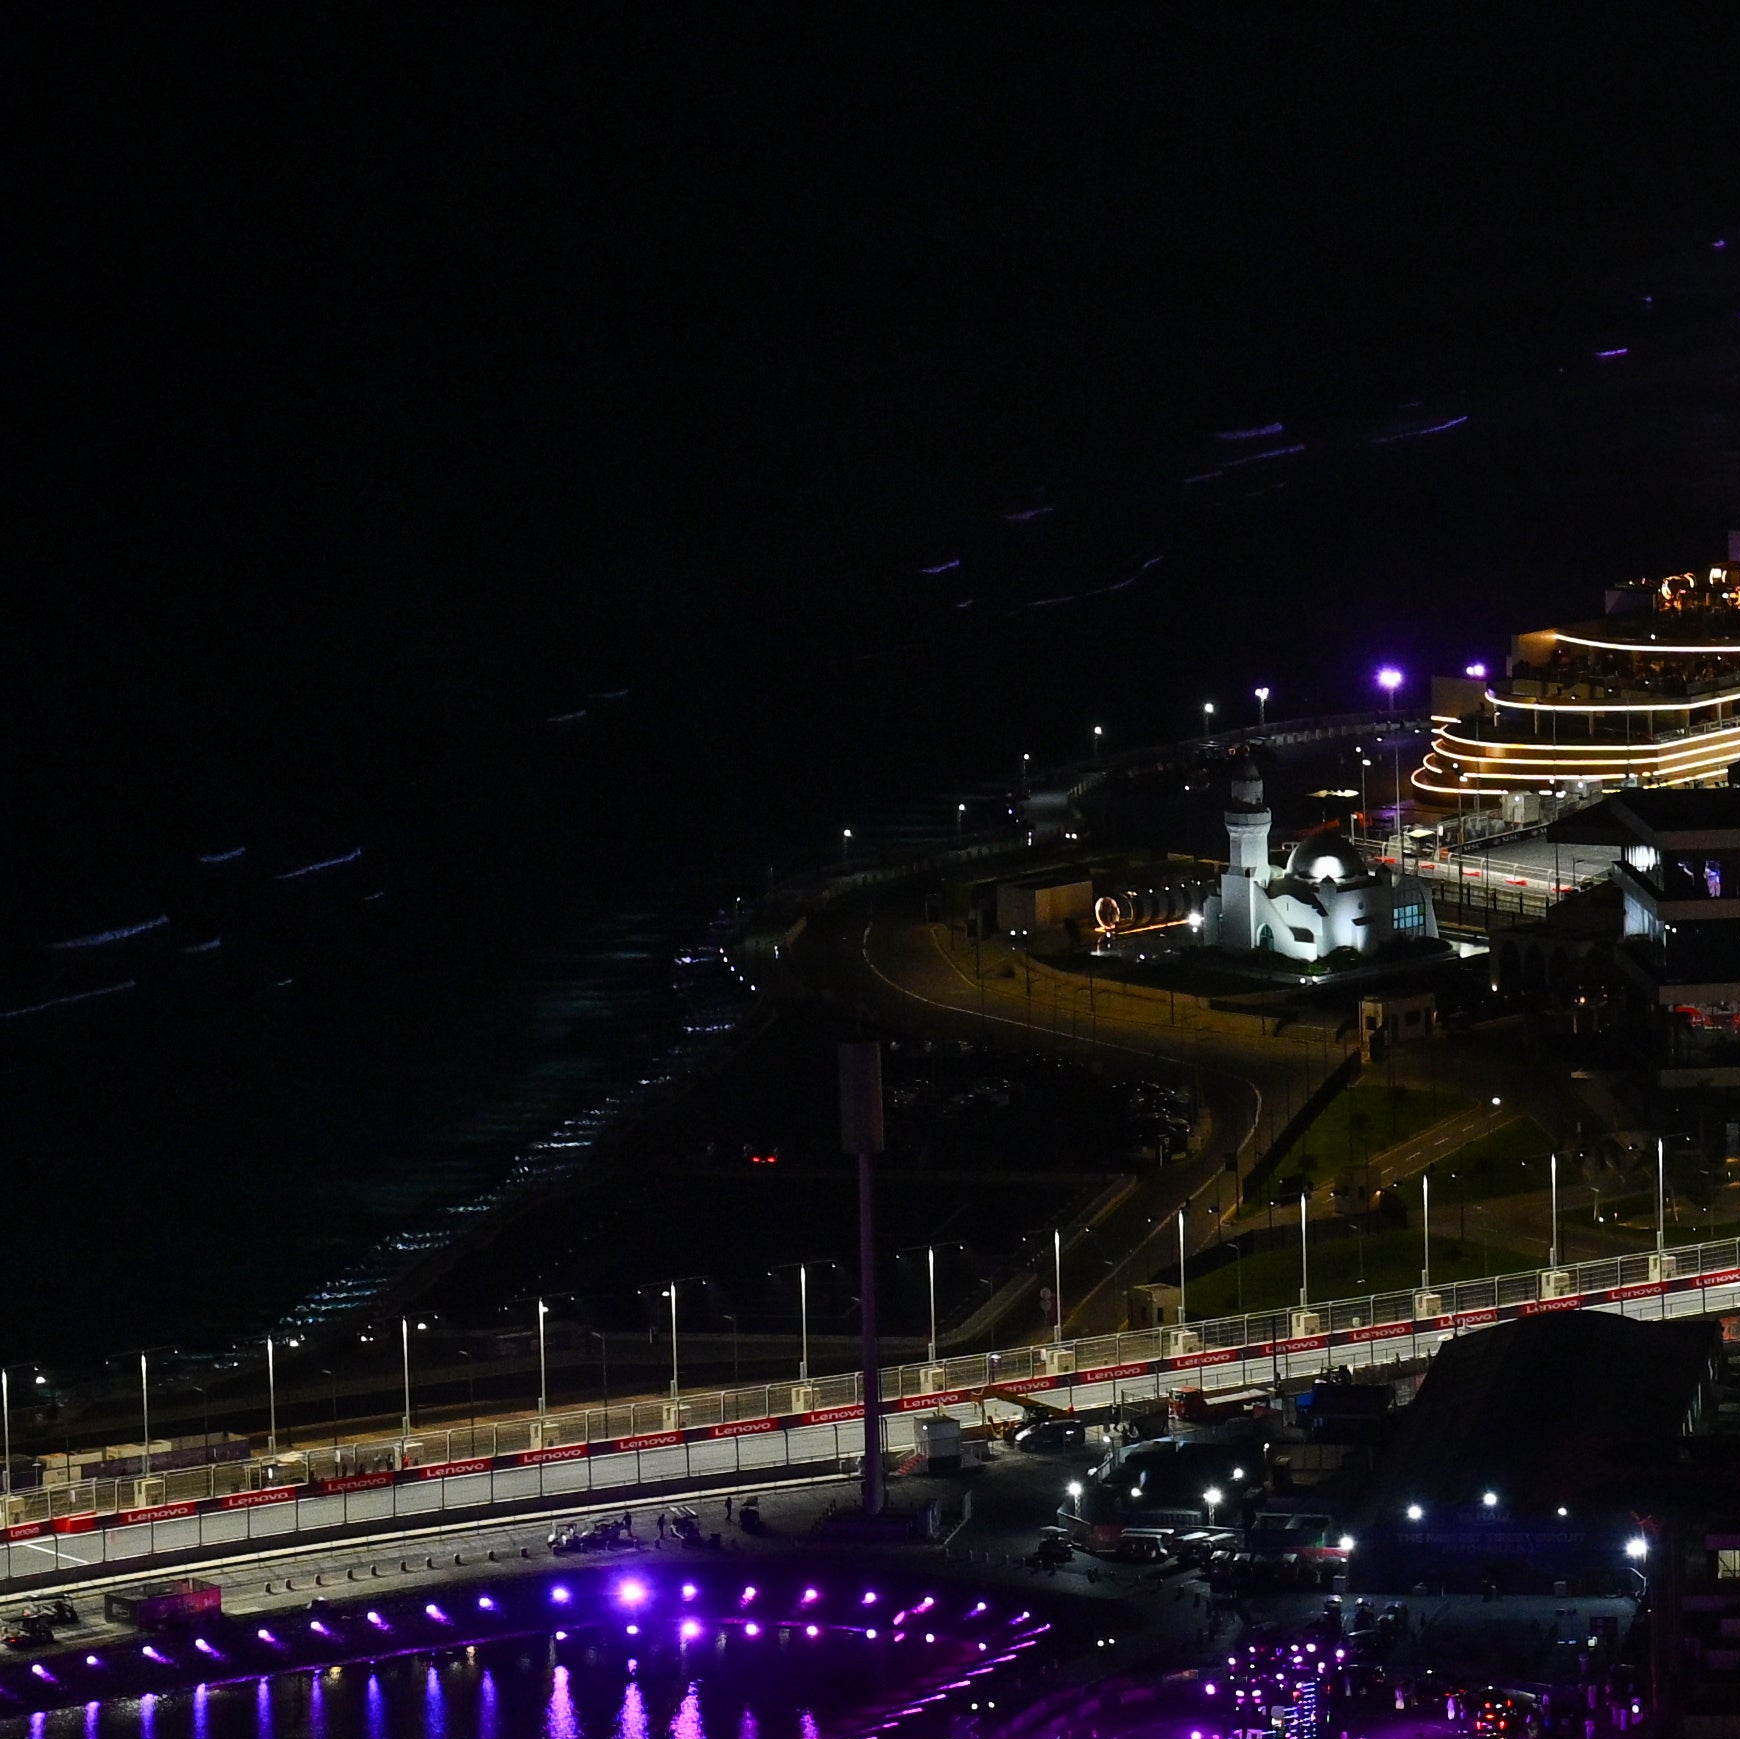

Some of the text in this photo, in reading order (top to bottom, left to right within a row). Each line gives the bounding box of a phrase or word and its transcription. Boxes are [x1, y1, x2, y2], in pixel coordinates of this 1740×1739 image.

[1610, 1285, 1662, 1300] Lenovo
[1526, 1298, 1578, 1313] Lenovo
[1440, 1311, 1492, 1327] Lenovo
[1353, 1324, 1406, 1339] Lenovo
[1265, 1337, 1319, 1353] Lenovo
[1176, 1351, 1231, 1367] Lenovo
[1086, 1364, 1142, 1381] Lenovo
[1000, 1378, 1051, 1393] enovo
[904, 1392, 959, 1408] Lenovo
[810, 1407, 865, 1423] Lenovo
[715, 1419, 772, 1436] Lenovo
[619, 1433, 677, 1449] Lenovo
[523, 1446, 582, 1463] Lenovo
[426, 1459, 485, 1477] Lenovo
[327, 1475, 388, 1492] Lenovo
[228, 1490, 289, 1507] Lenovo
[127, 1505, 188, 1523] Lenovo
[10, 1525, 39, 1538] Lenovo
